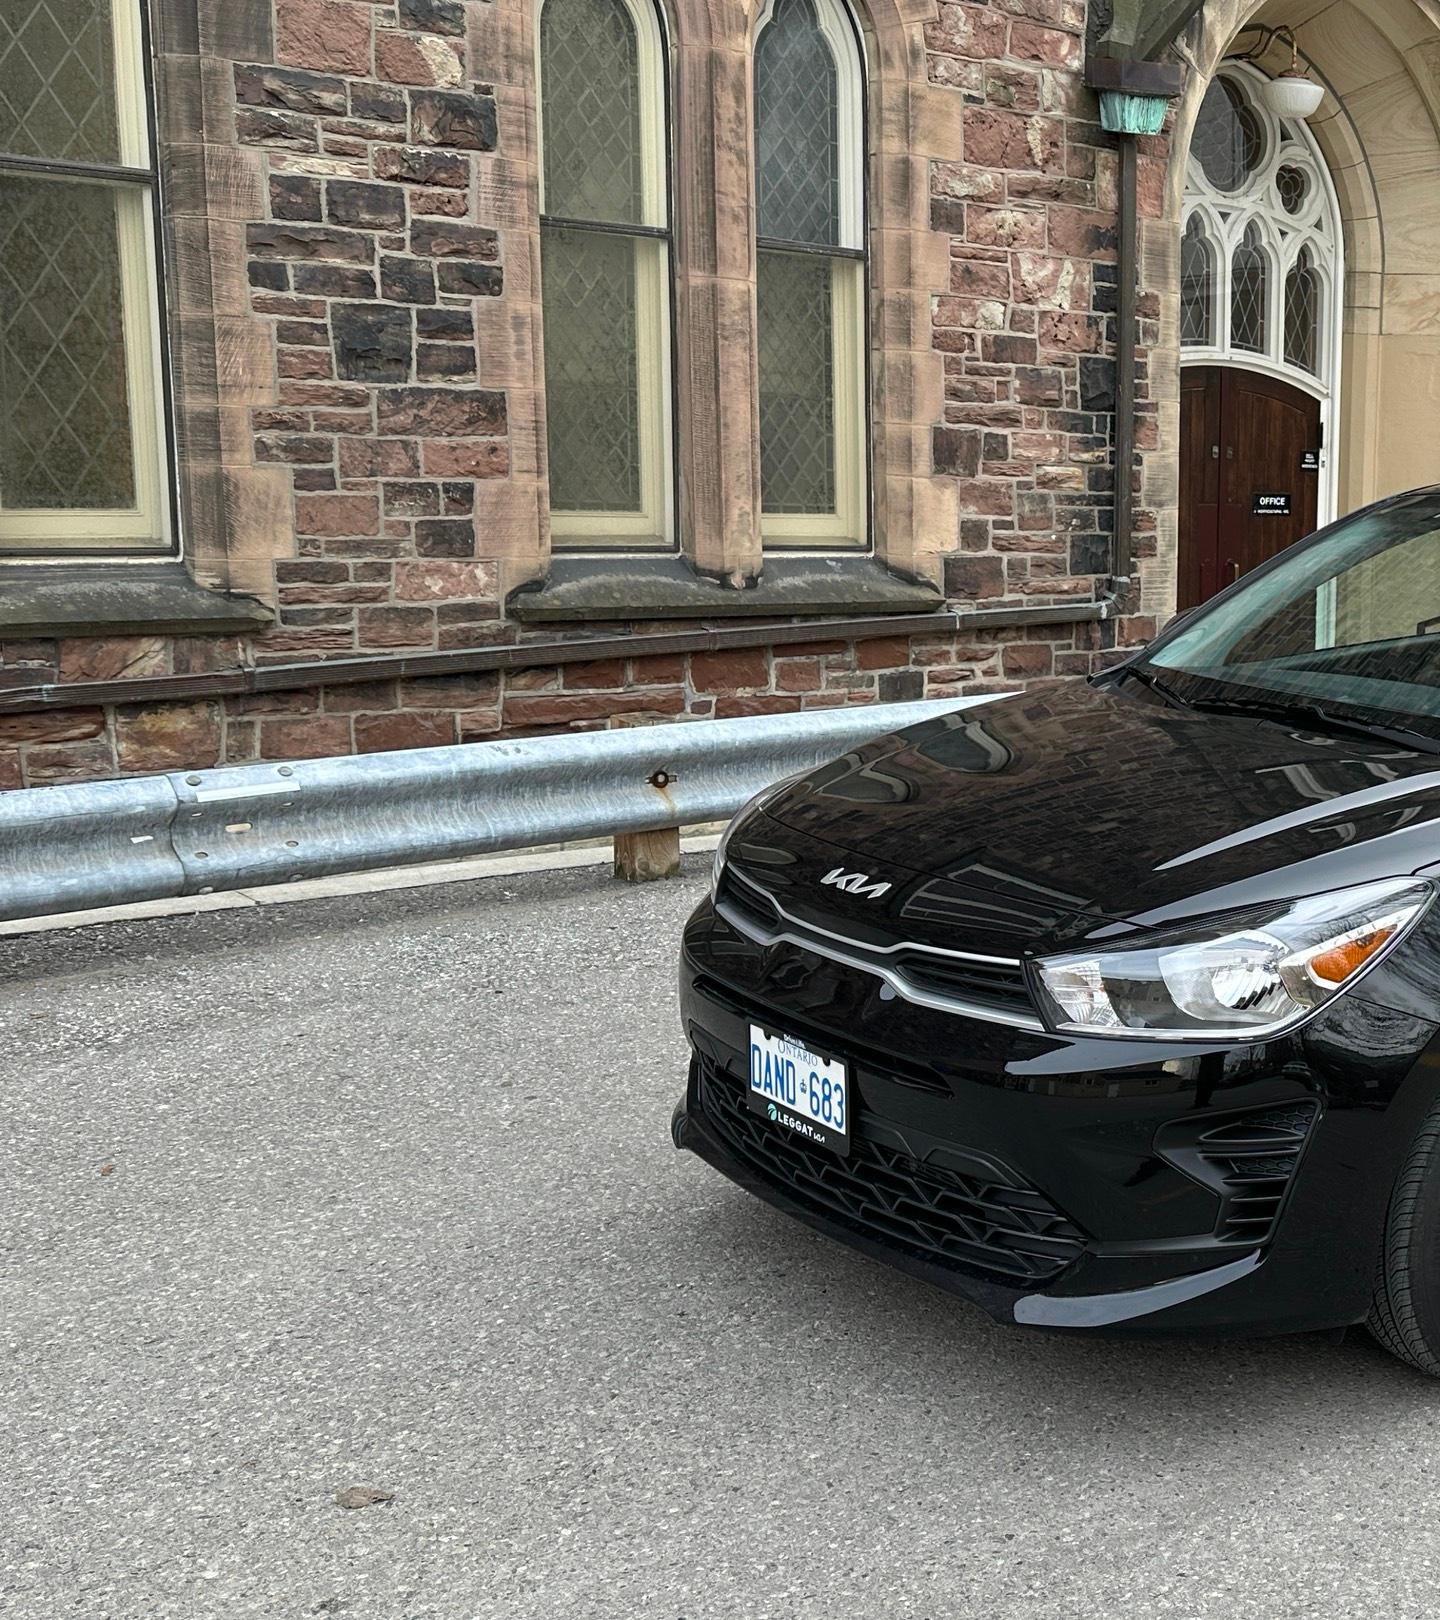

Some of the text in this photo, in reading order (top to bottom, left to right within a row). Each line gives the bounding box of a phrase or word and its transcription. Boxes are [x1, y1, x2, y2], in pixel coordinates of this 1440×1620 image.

[1259, 496, 1286, 506] OFFICE
[820, 867, 892, 899] KIA
[777, 1039, 818, 1067] ONTARIO
[751, 1043, 845, 1130] DAND 683
[777, 1111, 813, 1137] LEGGAT
